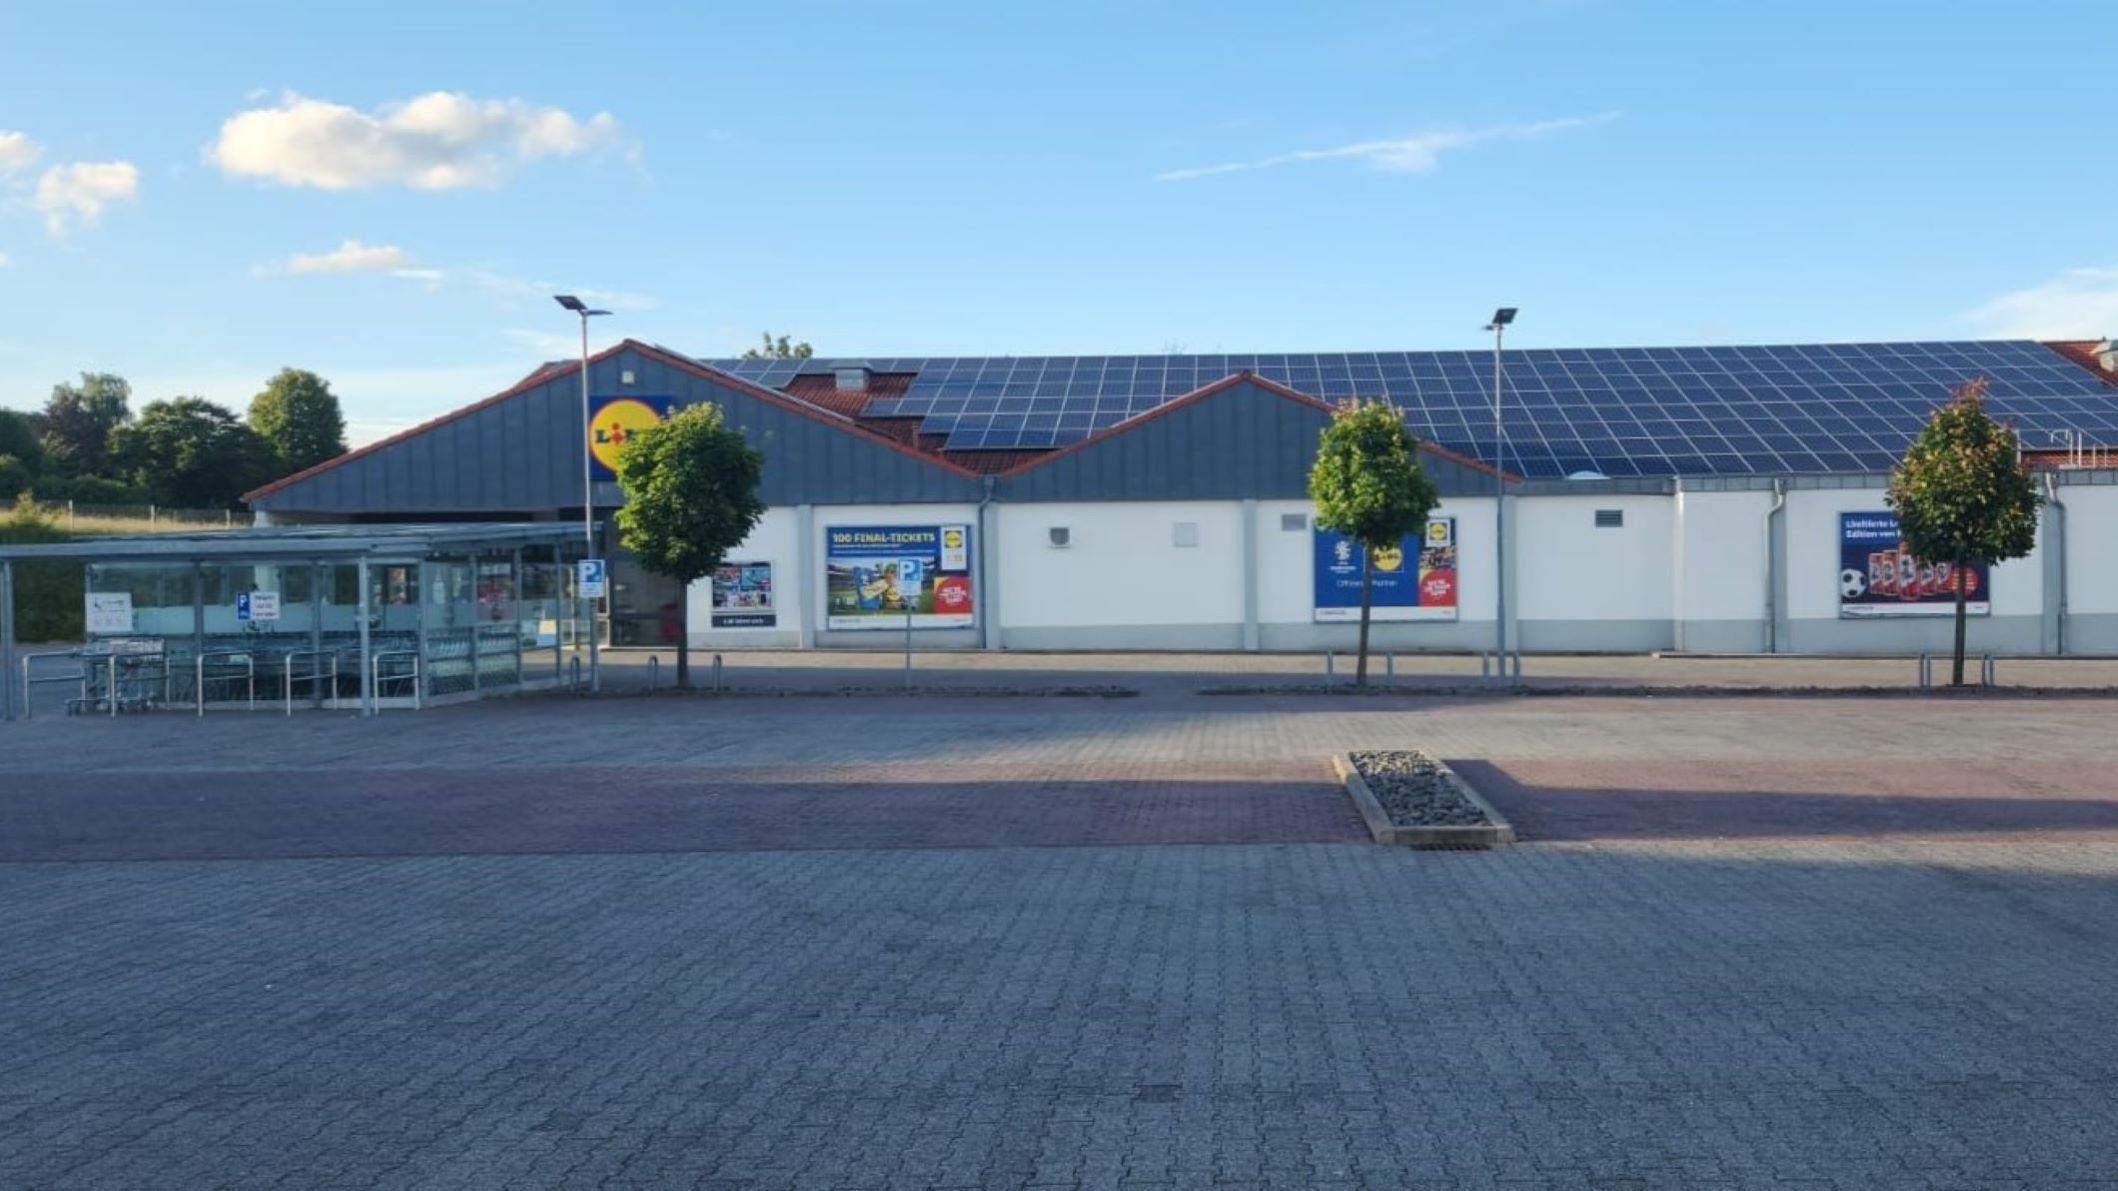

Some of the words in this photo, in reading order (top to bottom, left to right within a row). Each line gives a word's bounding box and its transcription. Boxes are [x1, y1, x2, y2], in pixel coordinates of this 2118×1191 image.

[833, 533, 852, 543] 100
[854, 533, 935, 543] FINAL-TICKETS
[581, 562, 597, 581] P
[901, 560, 915, 579] P
[239, 594, 248, 607] P
